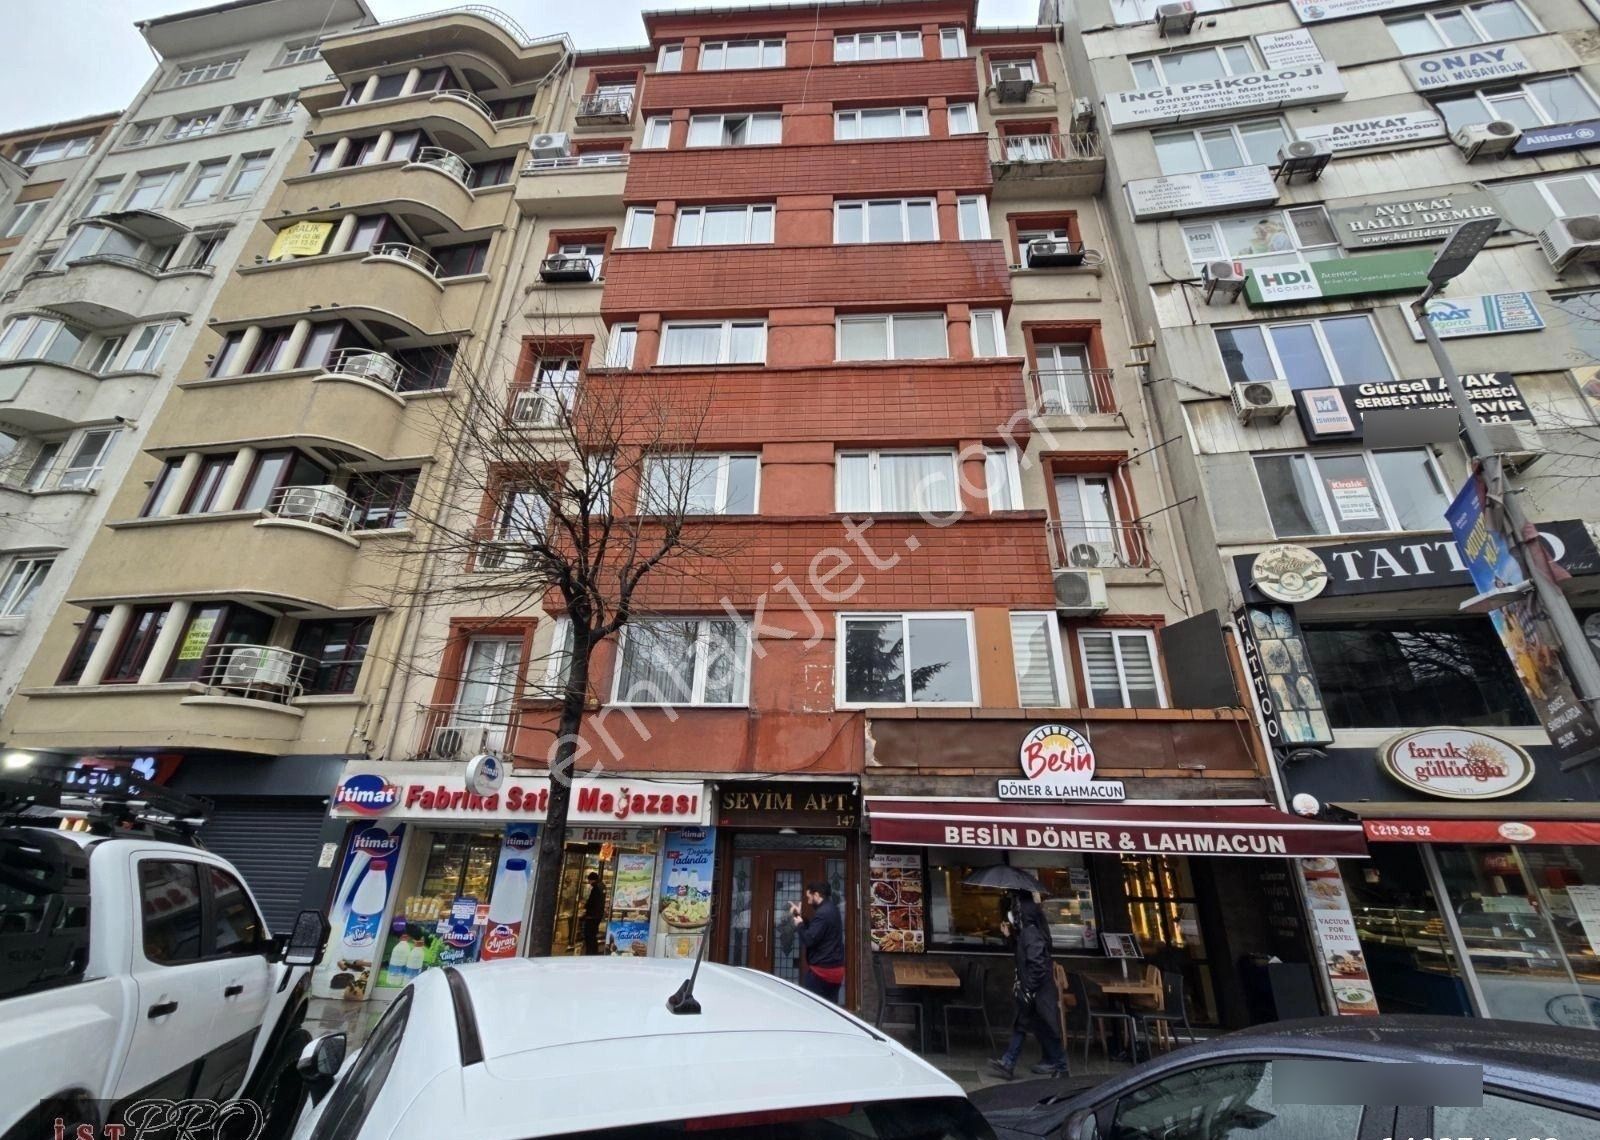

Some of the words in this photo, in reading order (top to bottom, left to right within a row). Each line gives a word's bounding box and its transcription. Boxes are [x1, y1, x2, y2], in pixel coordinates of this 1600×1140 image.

[1421, 48, 1505, 73] ONAY
[1120, 86, 1173, 103] İNCİ
[1181, 64, 1323, 94] PSİKOLOJİ
[1156, 89, 1235, 105] Danışmanlık
[1238, 81, 1290, 94] Merkezi
[1153, 104, 1178, 112] 0212
[1332, 116, 1408, 135] AVUKAT
[1526, 132, 1575, 145] Allianz
[1374, 198, 1452, 217] AVUKAT
[1349, 214, 1414, 232] HALİL
[1421, 205, 1496, 224] DEMİR
[1189, 232, 1211, 242] HDI
[1362, 226, 1454, 244] www.halildemi
[1261, 270, 1311, 287] HDI
[1433, 318, 1472, 329] igorta
[1358, 379, 1431, 396] Gürsel
[1354, 395, 1419, 410] SERBEST
[1423, 385, 1518, 404] MUHSEBECİ
[1237, 614, 1279, 738] TATTOO
[1408, 741, 1467, 759] faruk
[1024, 742, 1092, 779] Besin
[337, 786, 395, 804] itimat
[1001, 782, 1042, 797] DÖNER
[1045, 786, 1053, 796] &
[1055, 785, 1123, 798] LAHMACUN
[506, 785, 549, 812] Sat
[577, 786, 698, 820] Mağazası
[723, 789, 793, 811] SEVİM
[836, 815, 856, 827] 147
[583, 827, 628, 842] itimat
[681, 829, 706, 839] itimat
[945, 823, 1018, 846] BESİN
[1026, 826, 1112, 849] DÖNER
[1119, 832, 1136, 850] &
[1143, 832, 1287, 855] LAHMACUN
[1379, 825, 1399, 836] 219
[1400, 825, 1415, 836] 32
[355, 836, 396, 849] itimat
[506, 837, 535, 847] itimat
[1318, 918, 1351, 926] VACUUM
